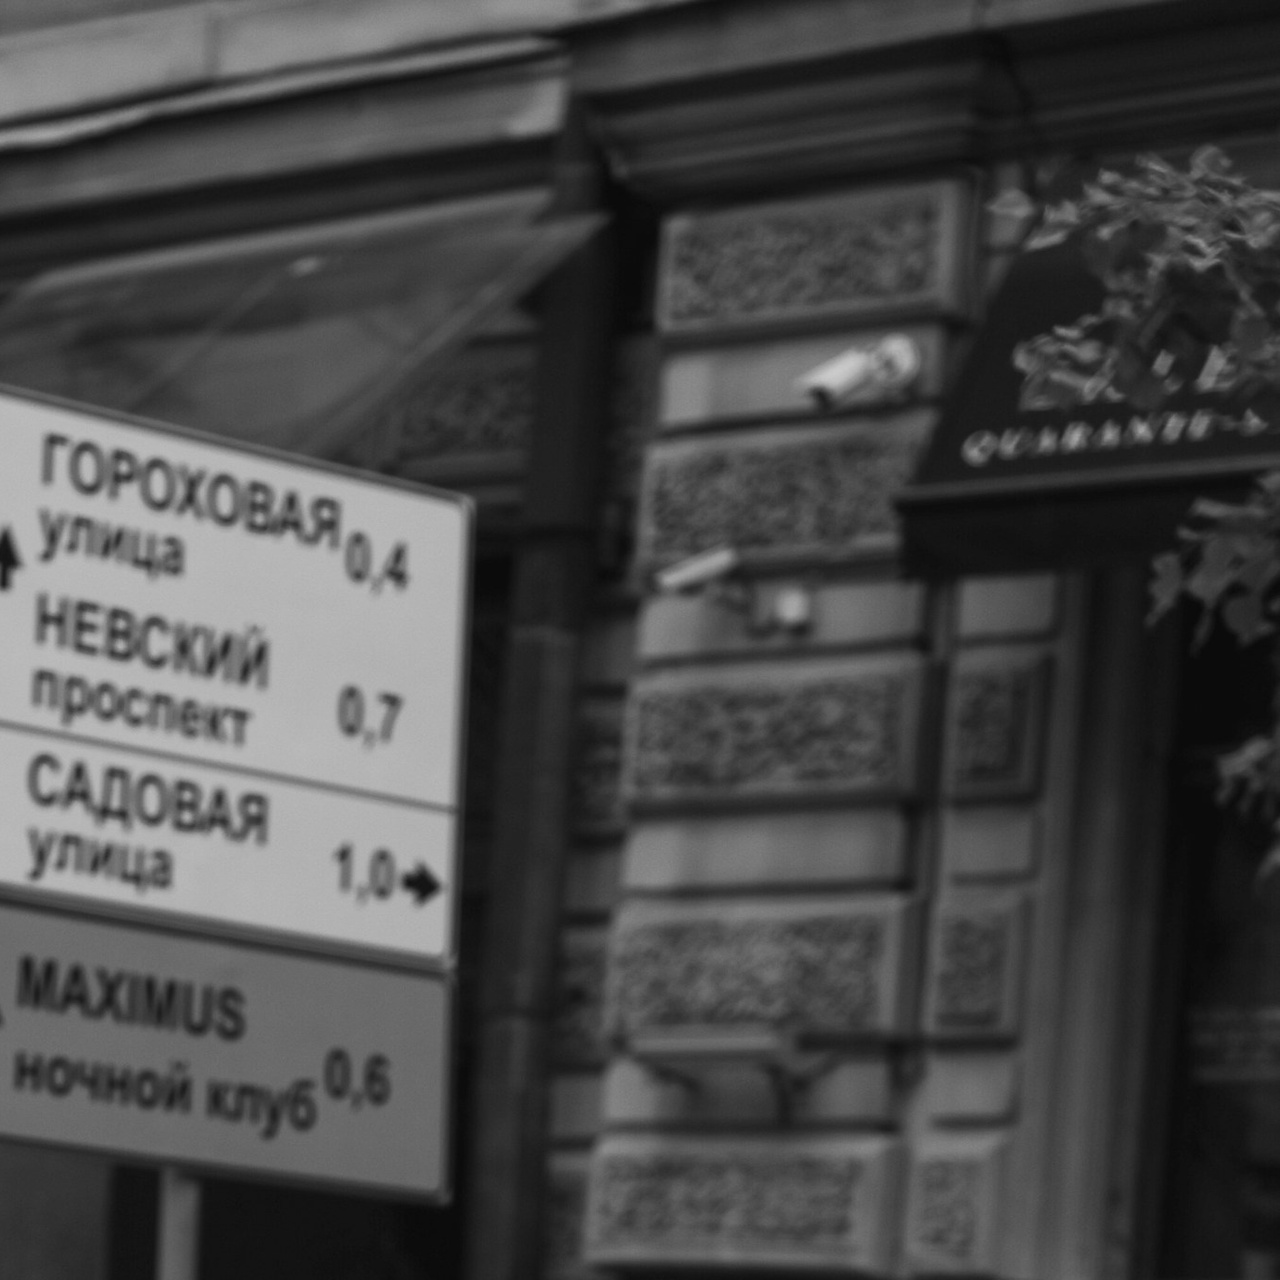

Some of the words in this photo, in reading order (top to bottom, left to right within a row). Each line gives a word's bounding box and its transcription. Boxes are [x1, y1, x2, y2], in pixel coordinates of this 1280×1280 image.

[41, 432, 342, 550] ГОРОХОВАЯ
[39, 508, 185, 579] улица
[343, 530, 410, 595] 0,4
[33, 592, 271, 691] НЕВСКИЙ
[31, 668, 251, 746] проспект
[336, 684, 405, 750] 0,7
[26, 752, 270, 847] САДОВАЯ
[26, 829, 175, 893] улица
[332, 842, 397, 904] 1,0
[17, 954, 248, 1043] MAXIMUS
[12, 1049, 194, 1116] ночной
[204, 1076, 320, 1141] клуб
[323, 1047, 393, 1111] 0,6
